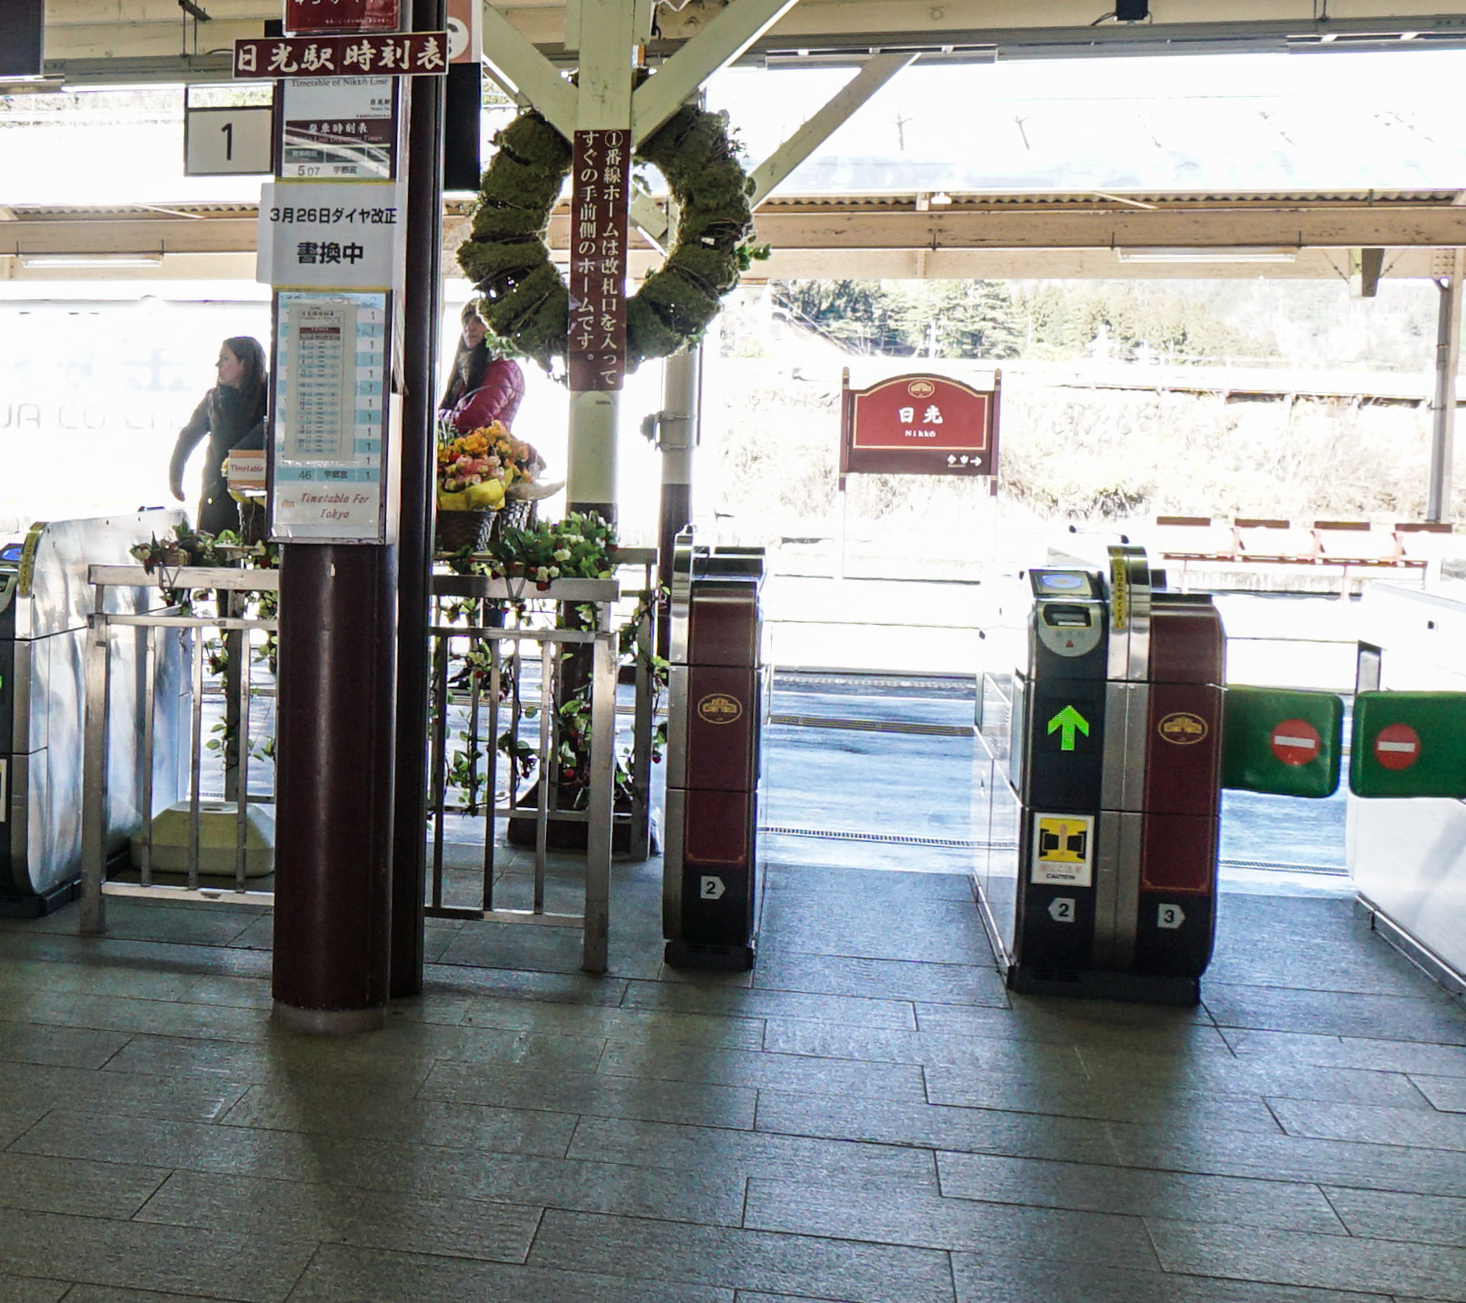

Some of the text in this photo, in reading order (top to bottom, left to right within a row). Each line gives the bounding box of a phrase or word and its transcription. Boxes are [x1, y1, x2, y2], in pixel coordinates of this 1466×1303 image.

[236, 38, 446, 73] 日光駅時刻表
[221, 122, 233, 161] 1
[269, 207, 398, 225] 3月26日ダイヤ改正
[297, 242, 364, 265] 書換中
[577, 130, 600, 362] すぐの手前側のホームです。
[599, 130, 624, 385] ①番線ホームは改札口を入って
[898, 404, 944, 424] 日光
[706, 881, 716, 895] 2
[1058, 903, 1069, 917] 2
[1163, 910, 1174, 923] 3
